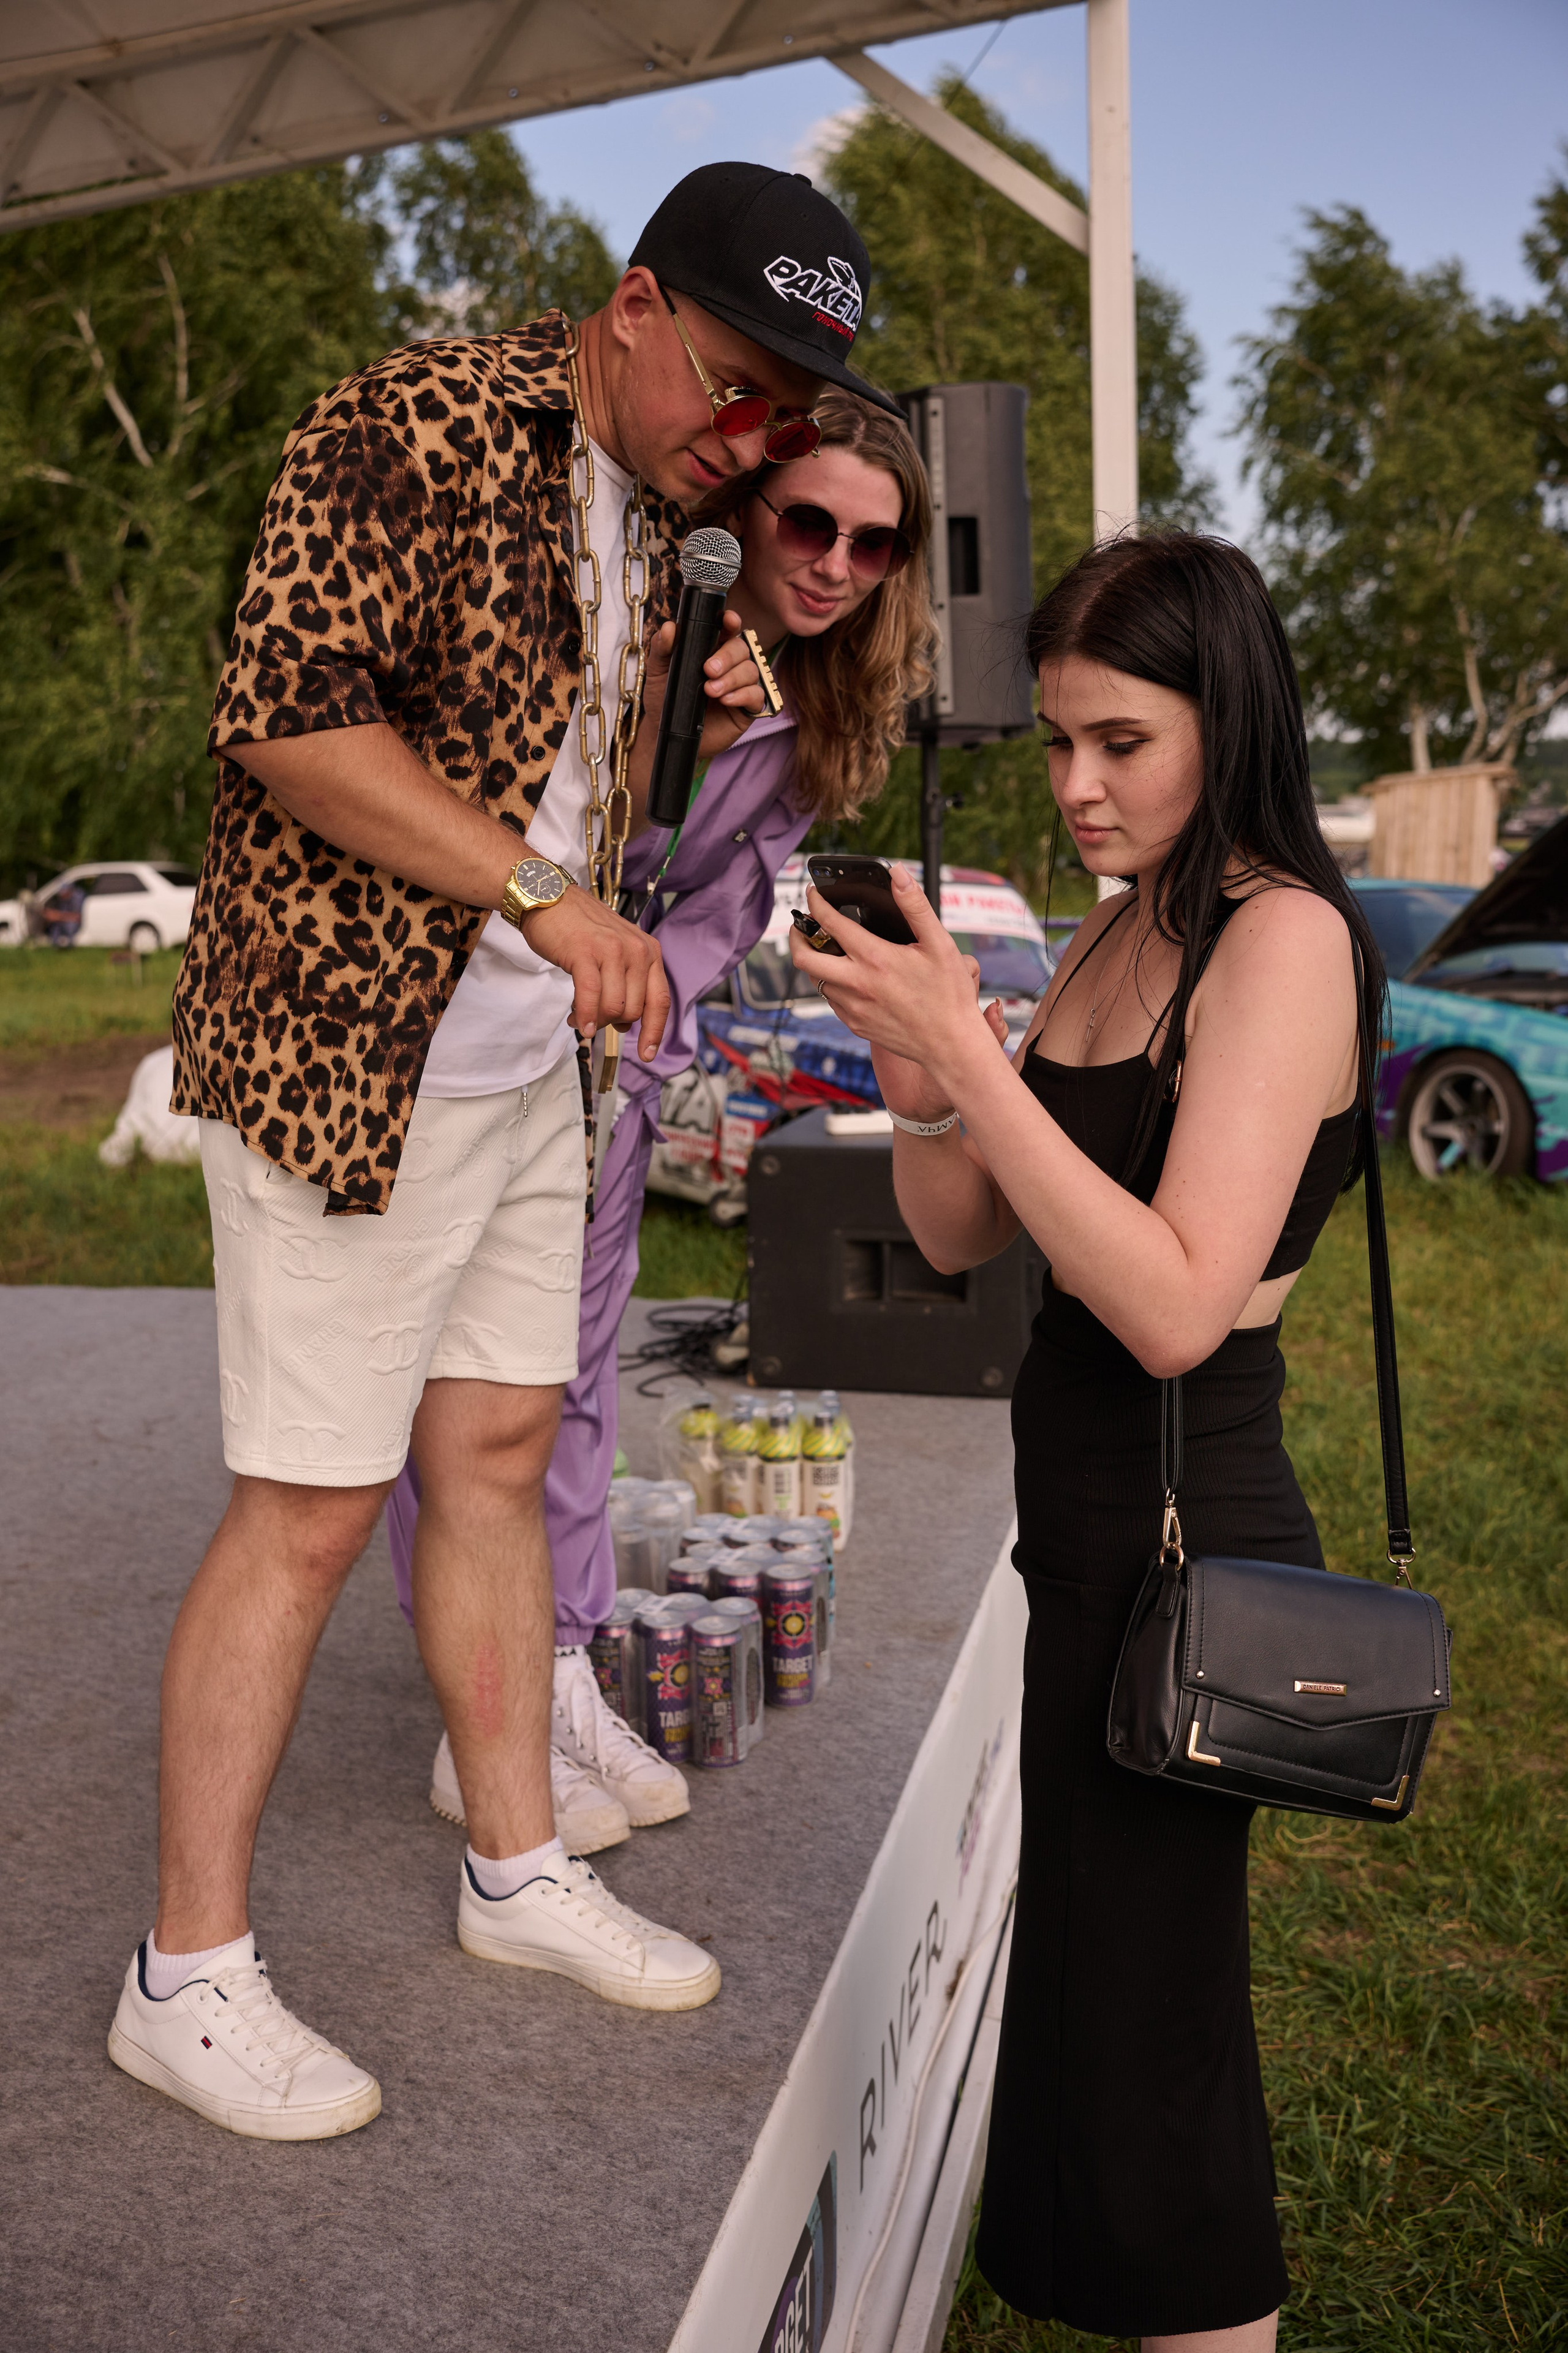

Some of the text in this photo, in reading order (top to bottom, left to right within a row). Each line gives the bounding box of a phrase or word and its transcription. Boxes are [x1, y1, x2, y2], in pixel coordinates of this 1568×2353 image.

[812, 311, 850, 337] ГОНОЧНЫЙ
[918, 1112, 957, 1133] АМЧА
[371, 1217, 429, 1283] CHANEL
[461, 1240, 519, 1282] HANEL
[281, 1318, 346, 1377] CHANEL
[773, 1655, 813, 1674] TARGET
[860, 1899, 948, 2194] RIVER
